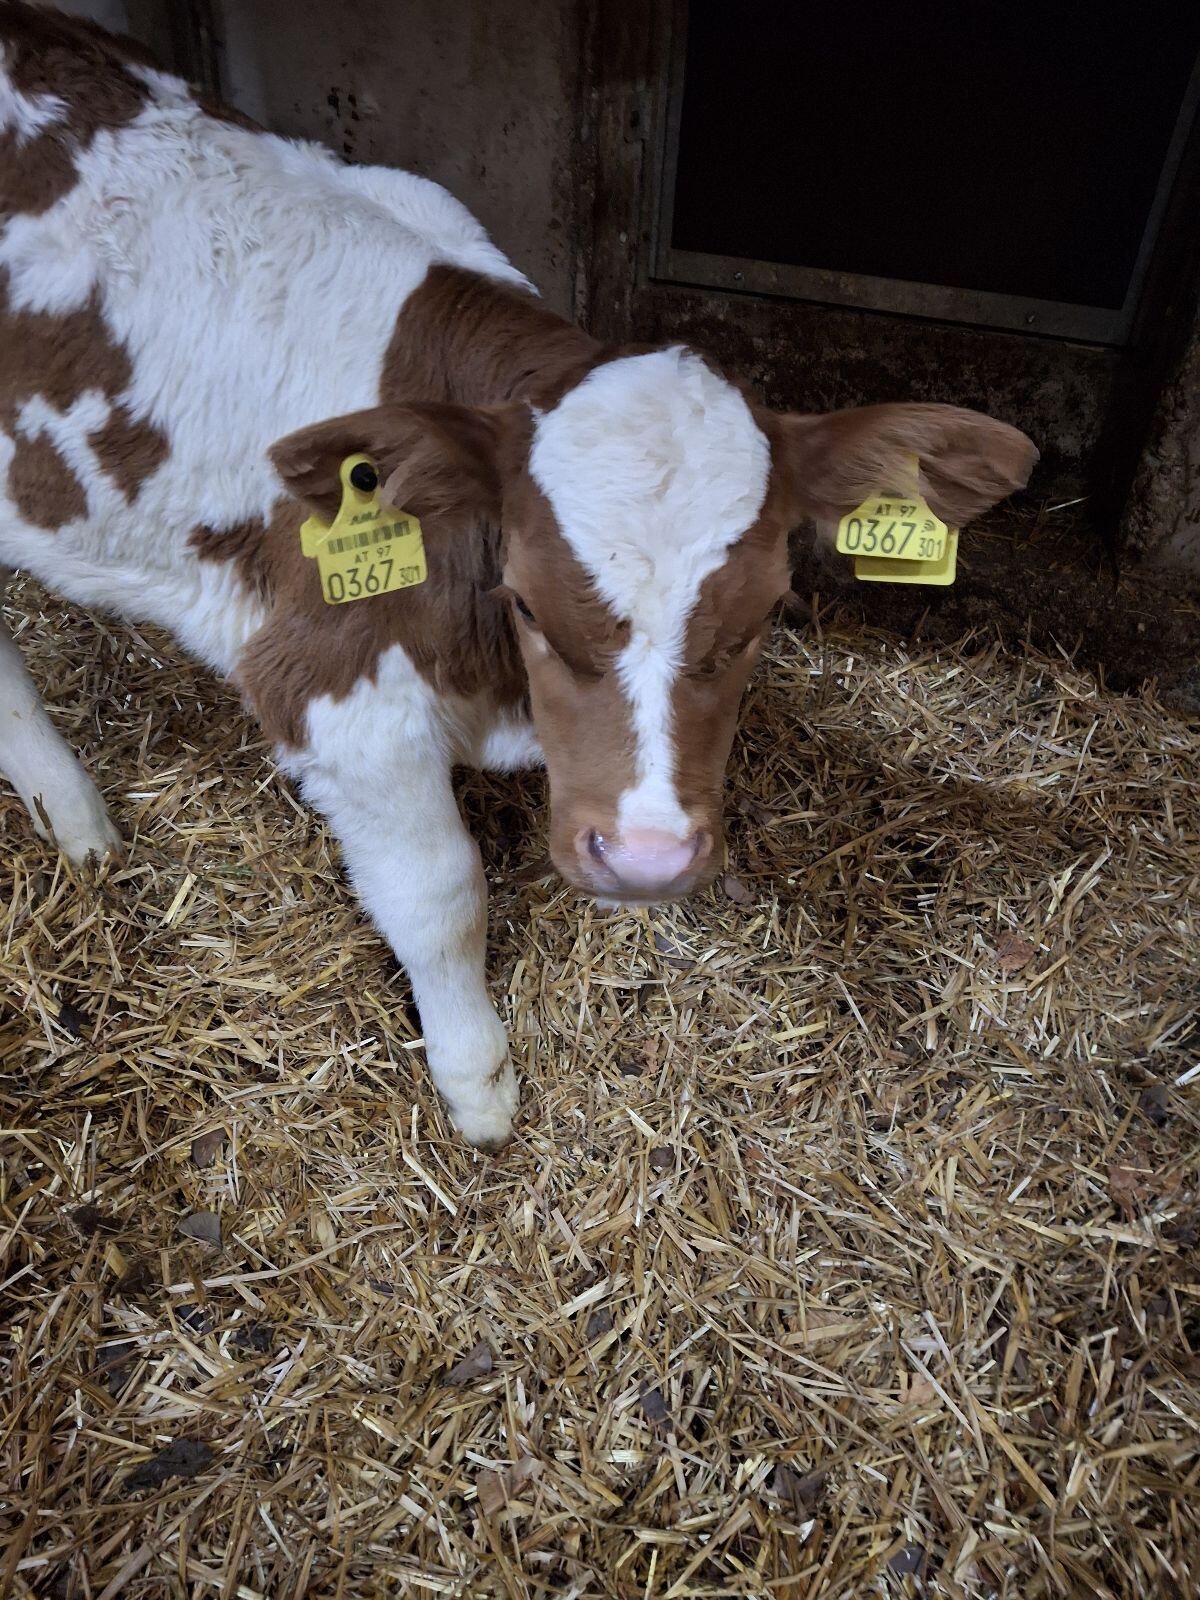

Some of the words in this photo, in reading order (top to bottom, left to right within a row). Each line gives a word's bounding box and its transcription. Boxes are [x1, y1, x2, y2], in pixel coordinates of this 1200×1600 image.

[875, 504, 892, 516] AT
[900, 505, 917, 517] 97
[846, 518, 917, 555] 0367
[918, 537, 942, 559] 301
[355, 551, 369, 563] AT
[377, 545, 392, 558] 97
[328, 559, 394, 601] 0367
